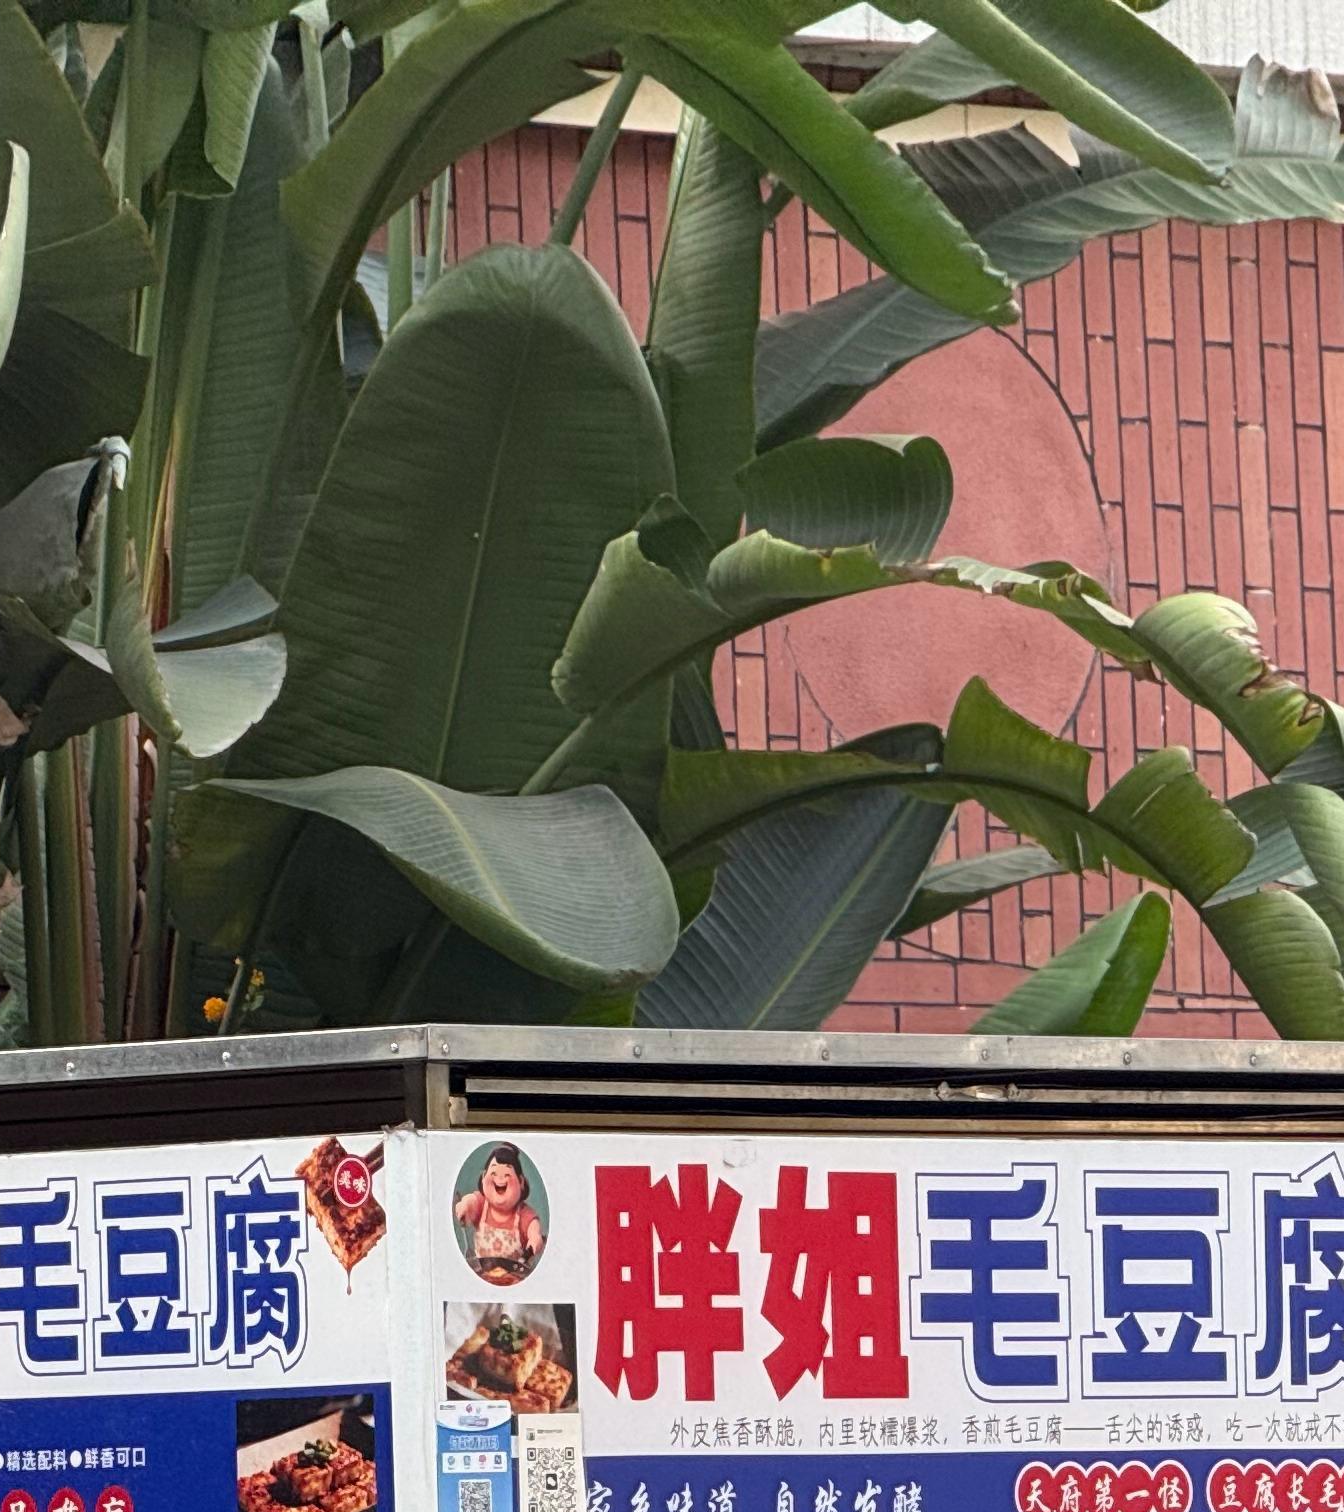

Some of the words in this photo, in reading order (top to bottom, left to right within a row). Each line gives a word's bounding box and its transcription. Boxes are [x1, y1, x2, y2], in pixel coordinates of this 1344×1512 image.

[6, 1449, 67, 1472] 精选配料
[84, 1447, 146, 1469] 鲜香可口
